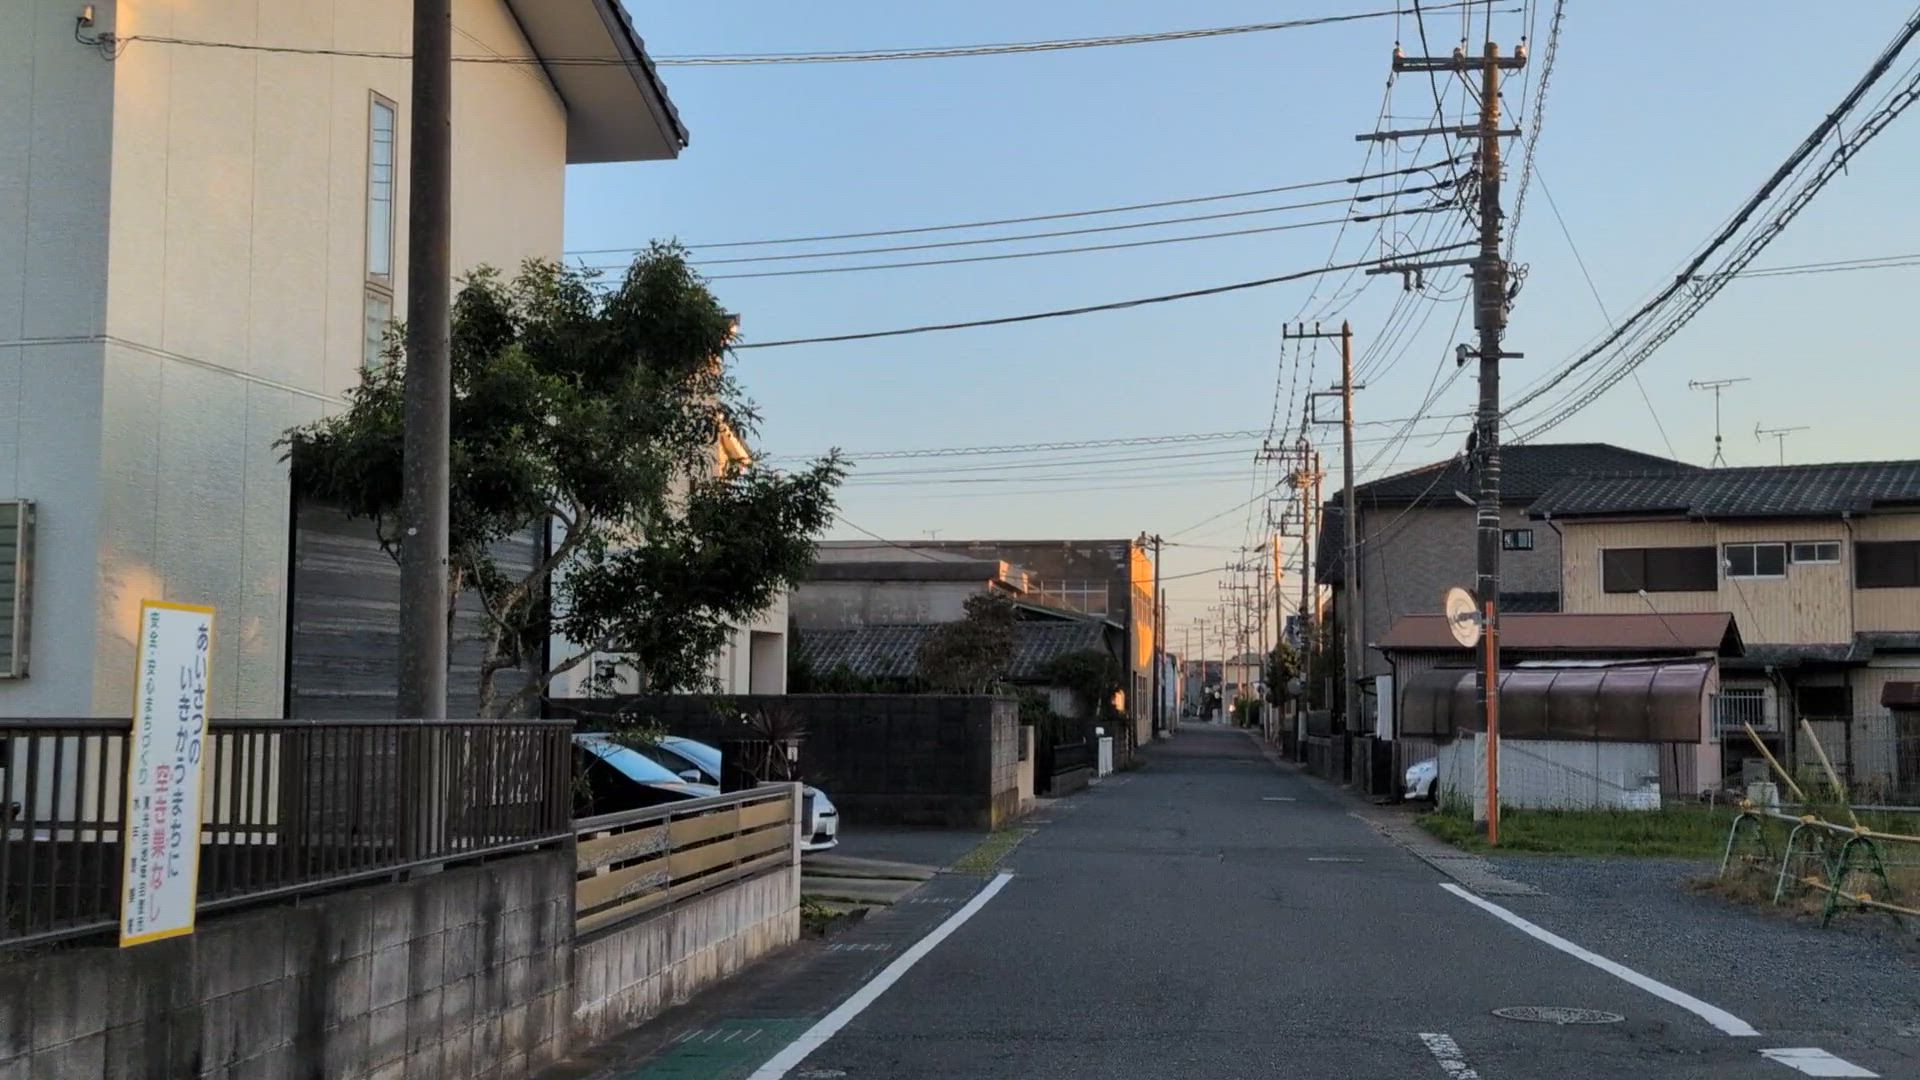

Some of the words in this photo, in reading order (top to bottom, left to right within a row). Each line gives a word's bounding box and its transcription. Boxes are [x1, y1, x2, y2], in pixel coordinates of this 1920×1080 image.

[167, 665, 192, 879] いきかうまちに
[188, 623, 208, 765] あいさつの
